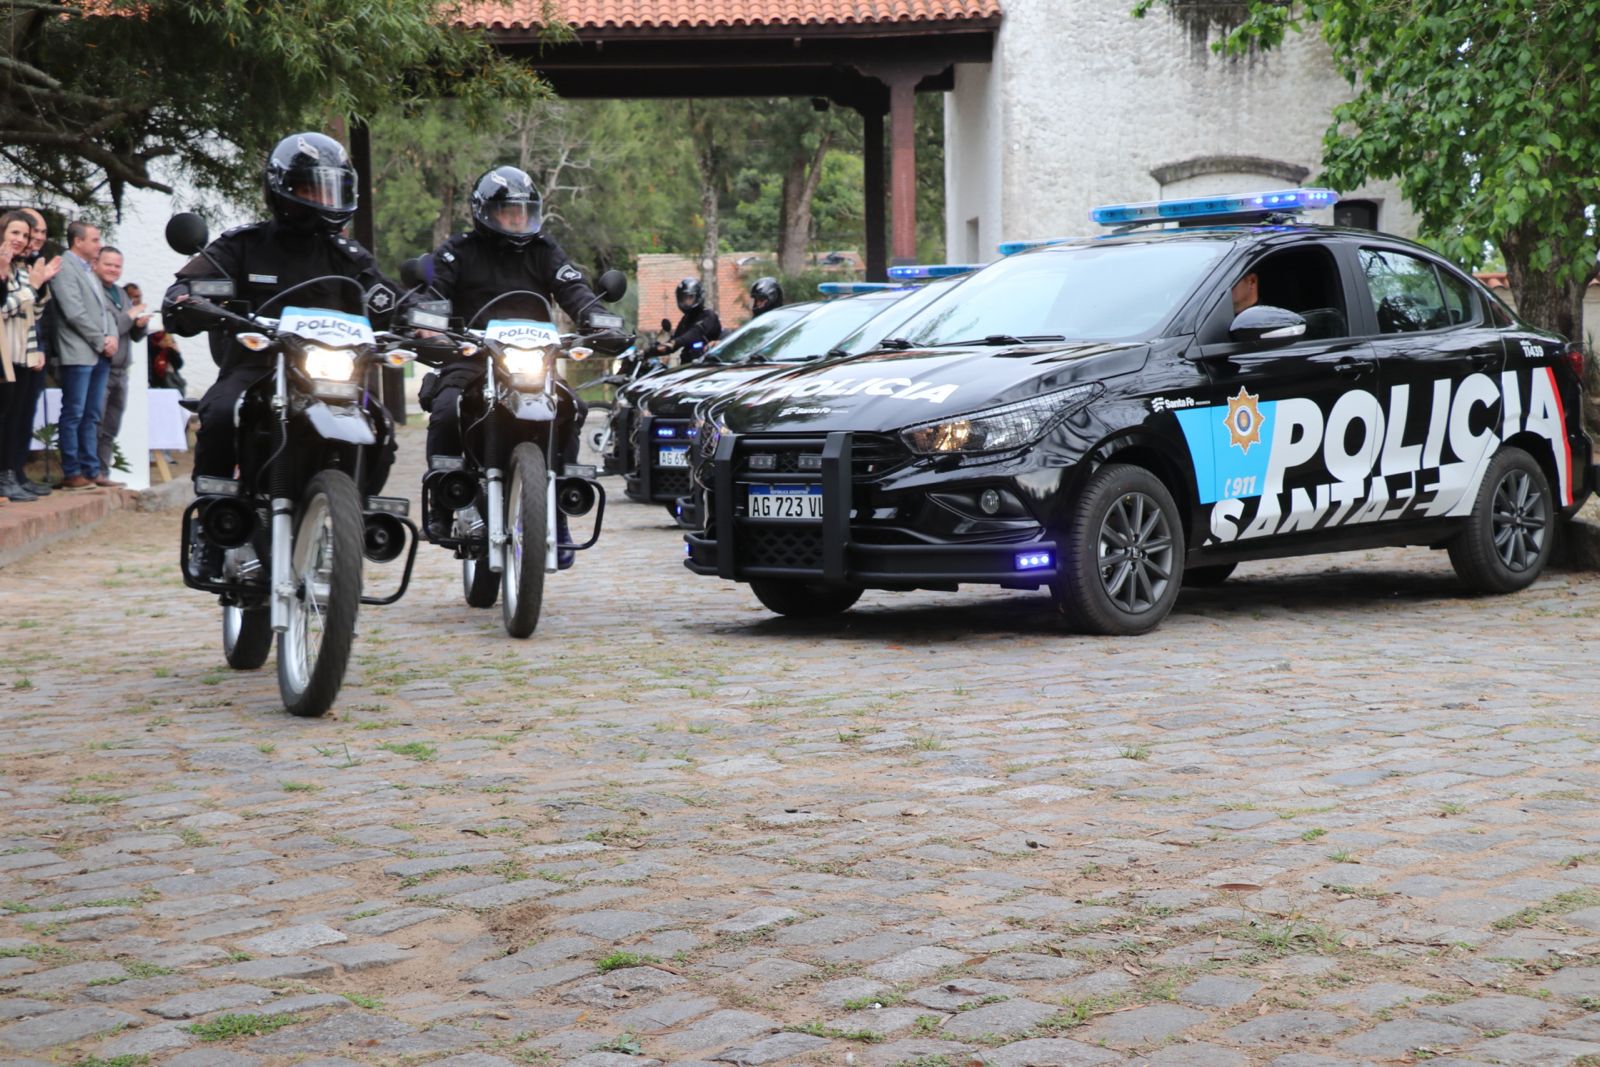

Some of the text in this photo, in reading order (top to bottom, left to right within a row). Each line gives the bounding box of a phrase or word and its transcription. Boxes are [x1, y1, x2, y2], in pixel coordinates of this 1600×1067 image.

[295, 320, 363, 338] POLICIA
[498, 328, 551, 340] POLICIA
[741, 377, 959, 405] POLICIA
[1164, 399, 1186, 409] Santa
[1185, 397, 1195, 407] Fe
[1263, 366, 1573, 507] POLICIA
[1232, 476, 1257, 497] 911
[752, 496, 771, 517] AG
[775, 496, 803, 517] 723
